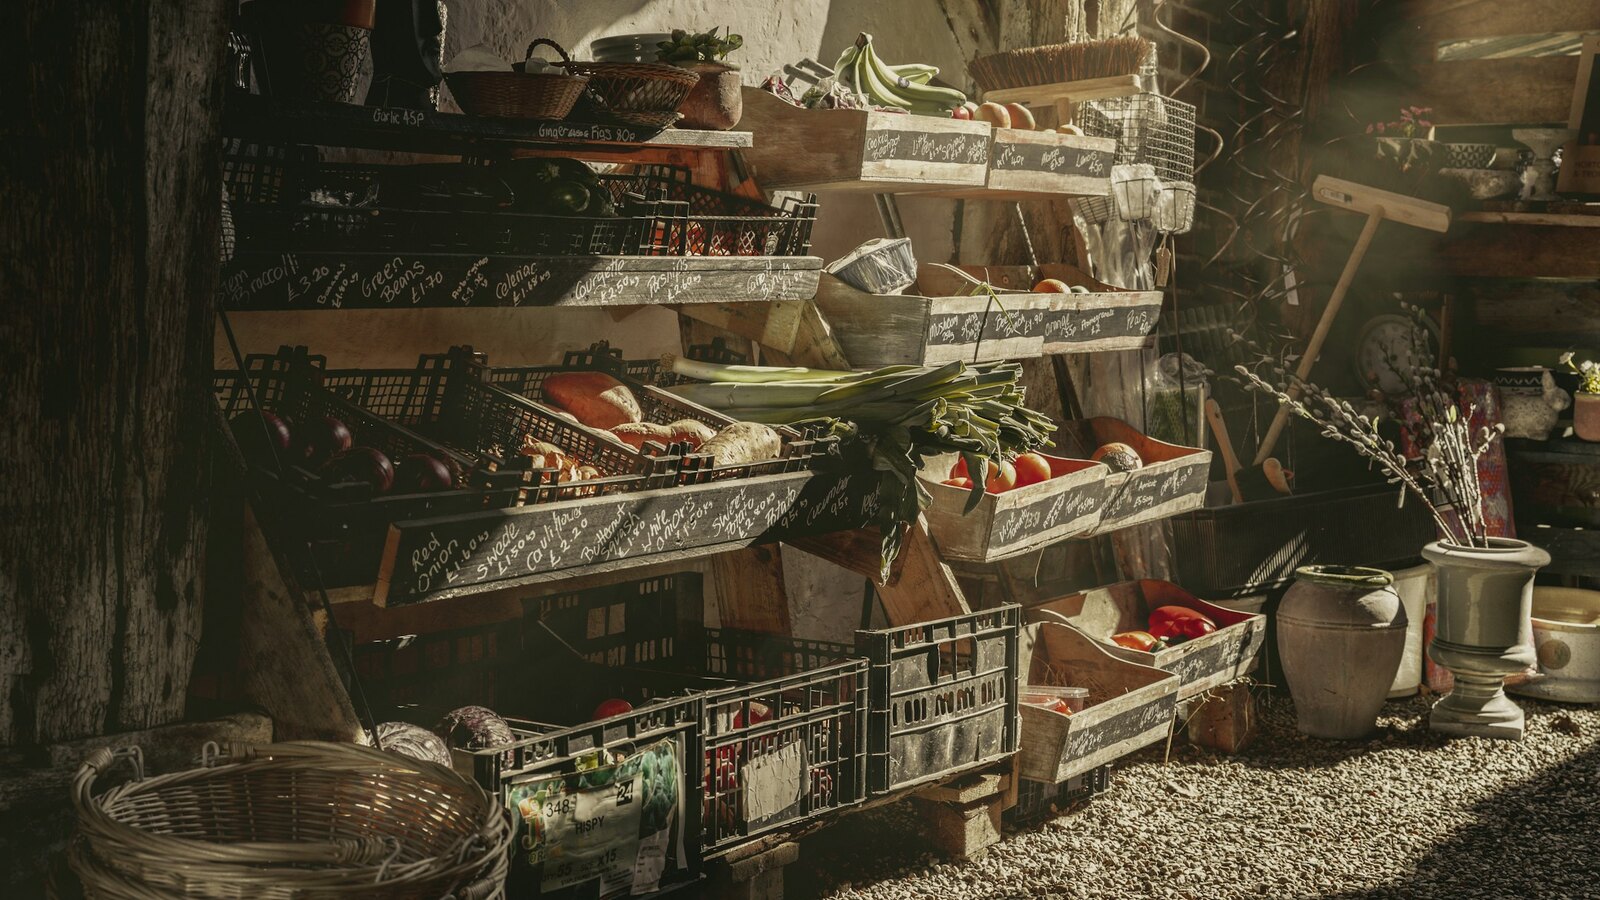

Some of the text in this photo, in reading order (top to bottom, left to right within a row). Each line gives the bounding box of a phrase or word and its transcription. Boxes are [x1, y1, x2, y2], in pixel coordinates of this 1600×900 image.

[373, 108, 424, 128] Garlic 45p
[616, 128, 636, 142] 80p
[1088, 161, 1103, 176] 45p
[362, 257, 404, 298] Green
[380, 261, 425, 303] Beans
[412, 270, 443, 304] £1.70
[496, 262, 538, 299] Celeriac
[412, 532, 441, 573] Red
[477, 522, 521, 581] Swede
[549, 518, 588, 568] £2.20
[601, 512, 641, 561] Squash
[418, 539, 459, 593] Onion
[546, 799, 570, 818] 348
[617, 783, 634, 802] 24
[575, 815, 605, 835] HISPY
